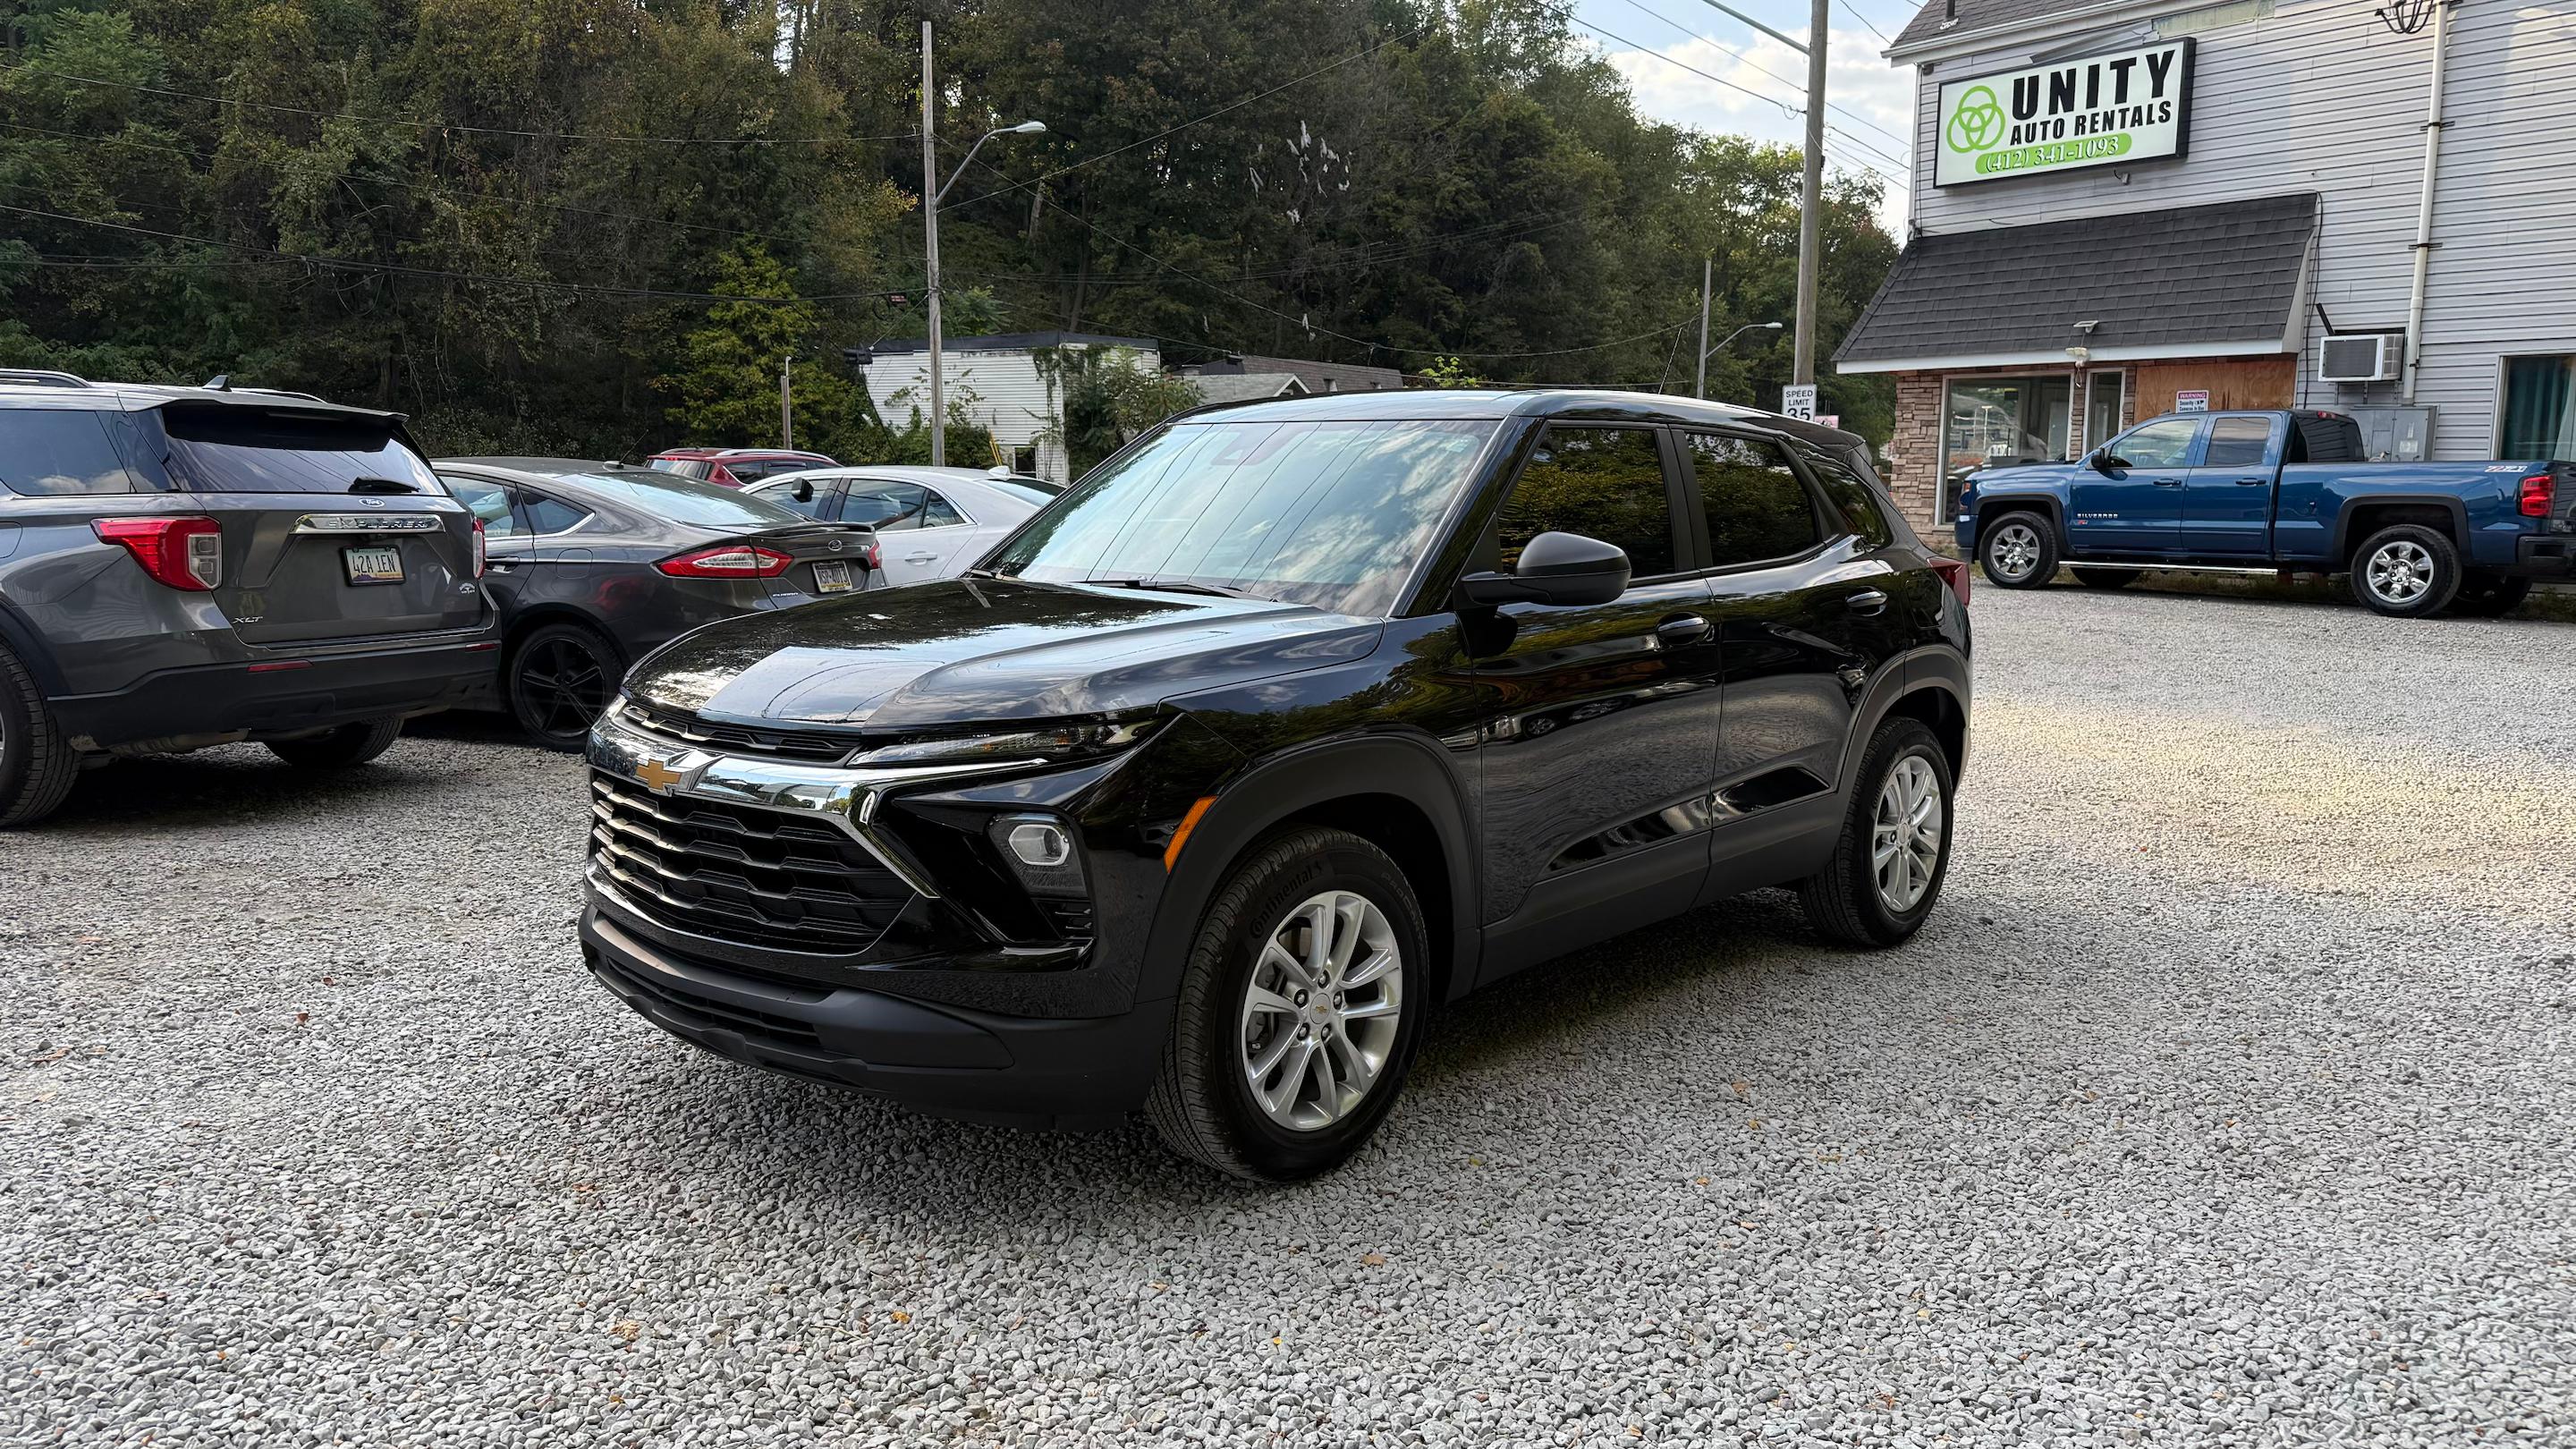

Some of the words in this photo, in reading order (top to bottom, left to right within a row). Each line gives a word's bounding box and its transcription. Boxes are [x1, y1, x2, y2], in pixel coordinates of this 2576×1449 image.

[2012, 49, 2176, 121] UNITY
[2010, 118, 2065, 146] AUTO
[2074, 100, 2172, 136] RENTALS
[1986, 148, 2030, 173] (412)
[2033, 136, 2120, 166] 341-1093
[1785, 389, 1813, 398] SPEED
[1787, 407, 1810, 420] 35
[328, 520, 428, 529] EXPLORER
[1250, 863, 1313, 939] Continental
